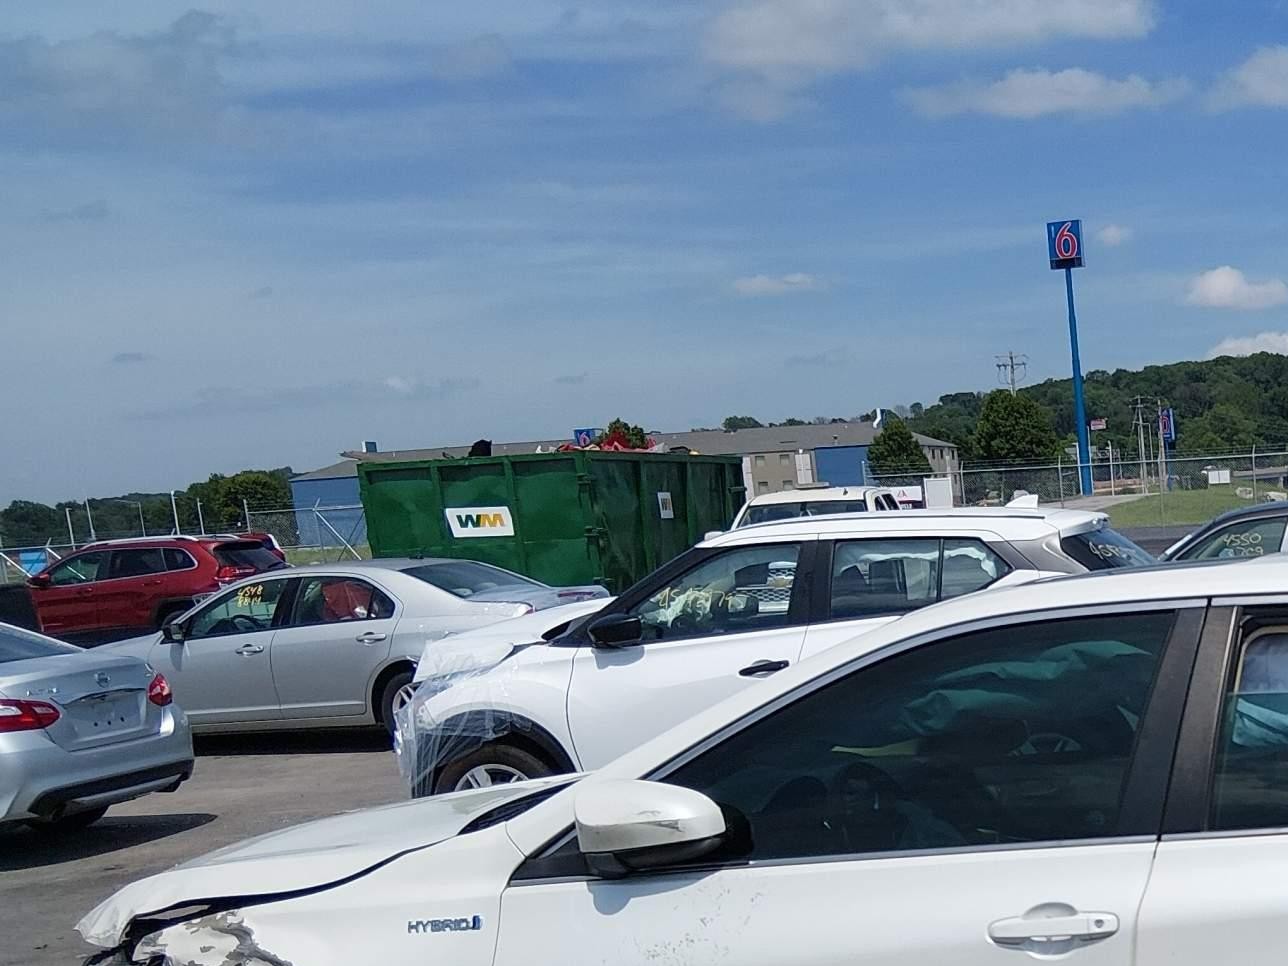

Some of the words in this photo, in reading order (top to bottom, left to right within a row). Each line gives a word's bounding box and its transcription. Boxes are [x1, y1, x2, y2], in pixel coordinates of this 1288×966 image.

[1055, 221, 1077, 259] 6
[456, 513, 505, 528] WM
[407, 918, 469, 934] HYBRID
